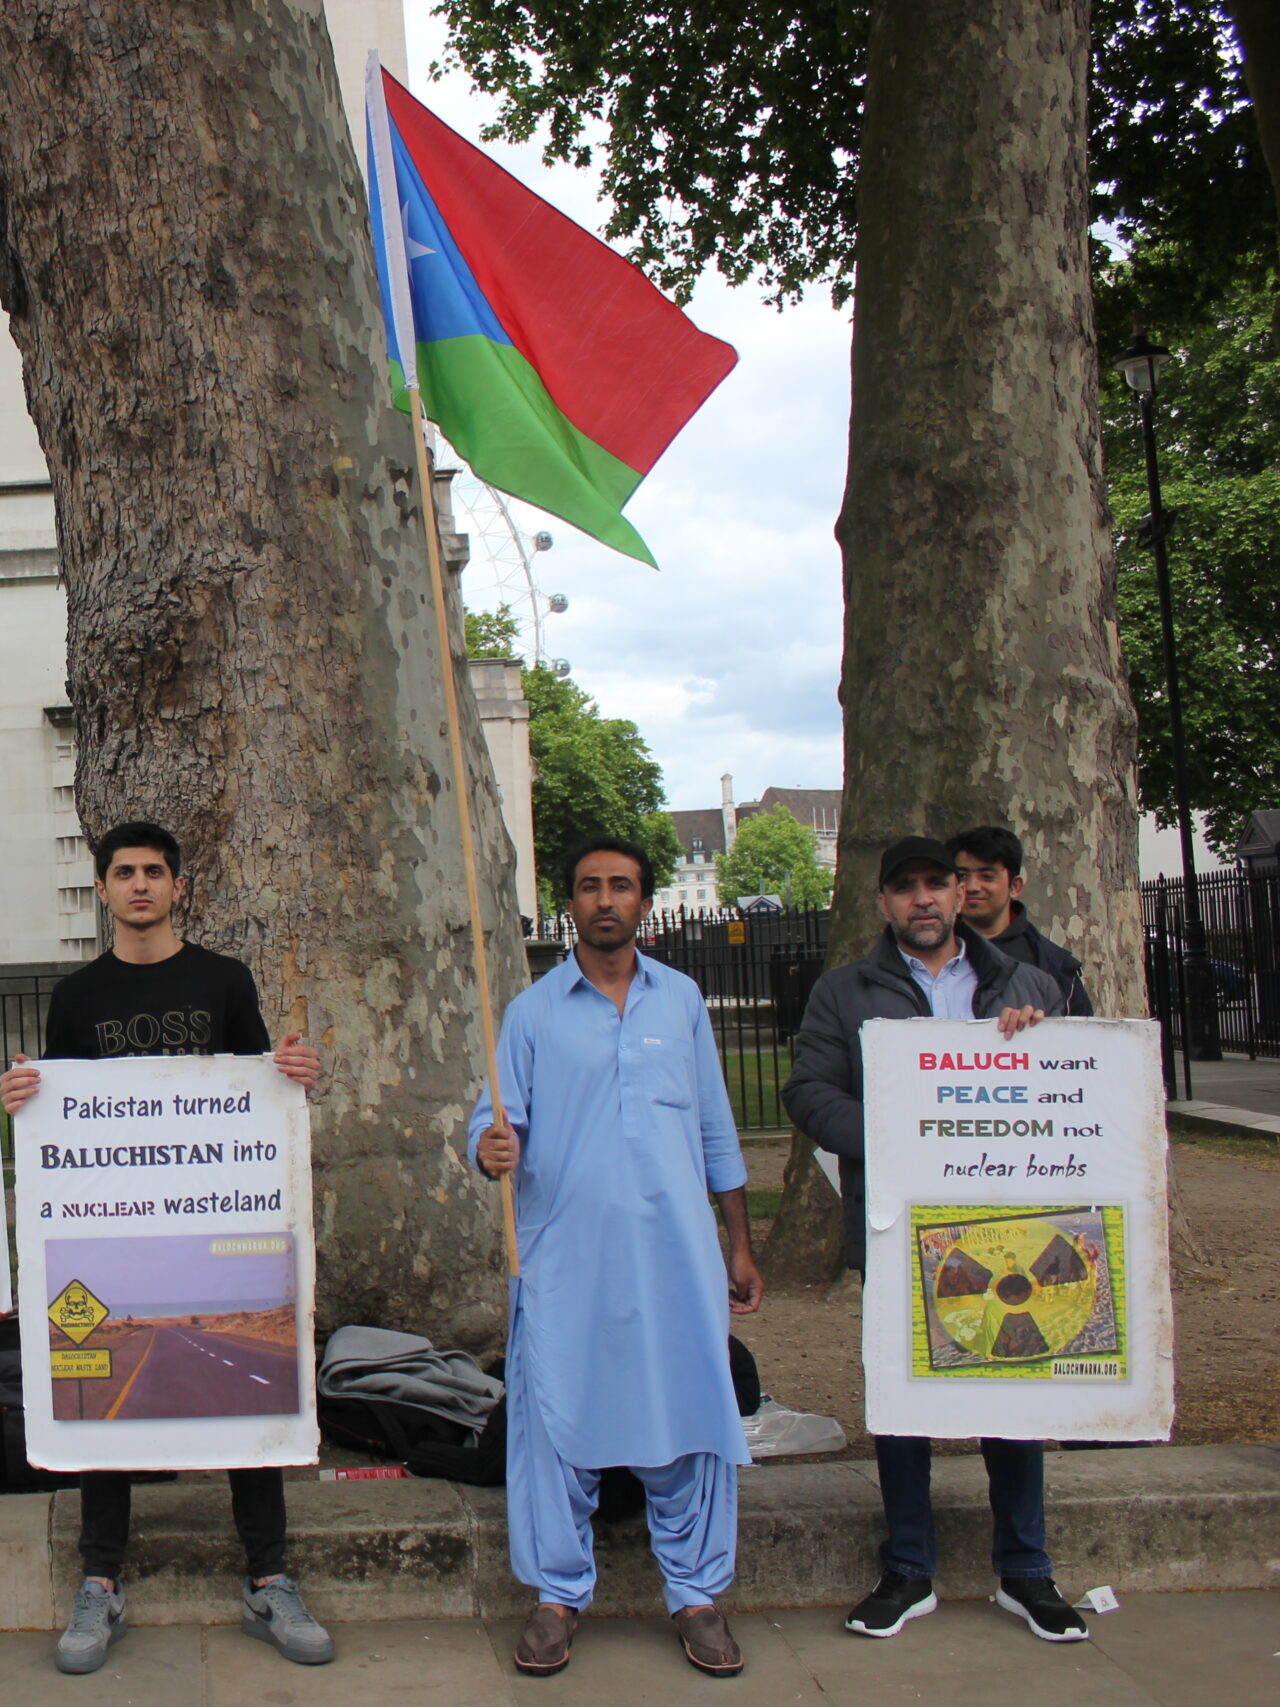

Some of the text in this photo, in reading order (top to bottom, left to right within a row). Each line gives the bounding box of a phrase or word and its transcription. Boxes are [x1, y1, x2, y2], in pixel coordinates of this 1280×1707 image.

[95, 1010, 212, 1056] BOSS
[919, 1053, 1098, 1070] BALUCH want
[63, 1091, 251, 1119] Pakistan turned
[937, 1086, 1084, 1103] PEACE and
[919, 1120, 1103, 1137] FREEDOM not
[40, 1140, 277, 1169] BALUCHISTAN into
[943, 1152, 1088, 1178] nuclear bombs
[40, 1189, 282, 1218] a NUCLEAR wasteland
[1053, 1362, 1118, 1376] BALOCHWARNA.ORG
